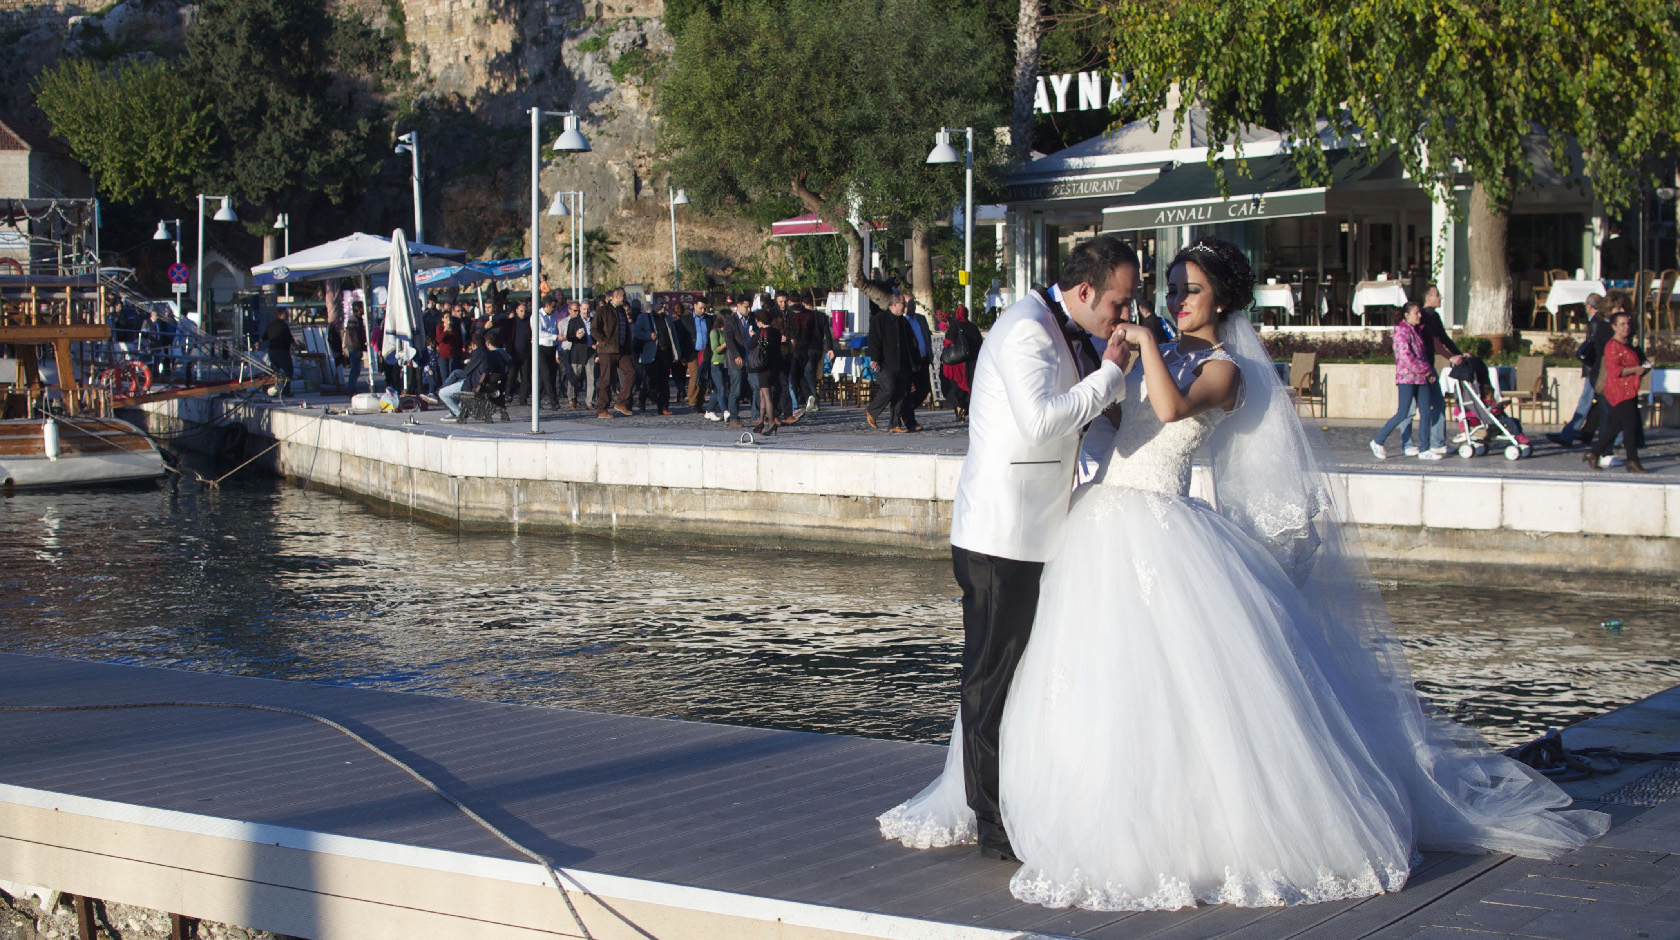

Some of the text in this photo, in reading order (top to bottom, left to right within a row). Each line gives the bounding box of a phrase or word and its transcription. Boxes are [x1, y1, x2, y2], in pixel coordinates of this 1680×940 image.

[1033, 70, 1160, 115] AYNA
[1052, 179, 1122, 196] RESTAURANT
[1155, 205, 1212, 223] AYNALI
